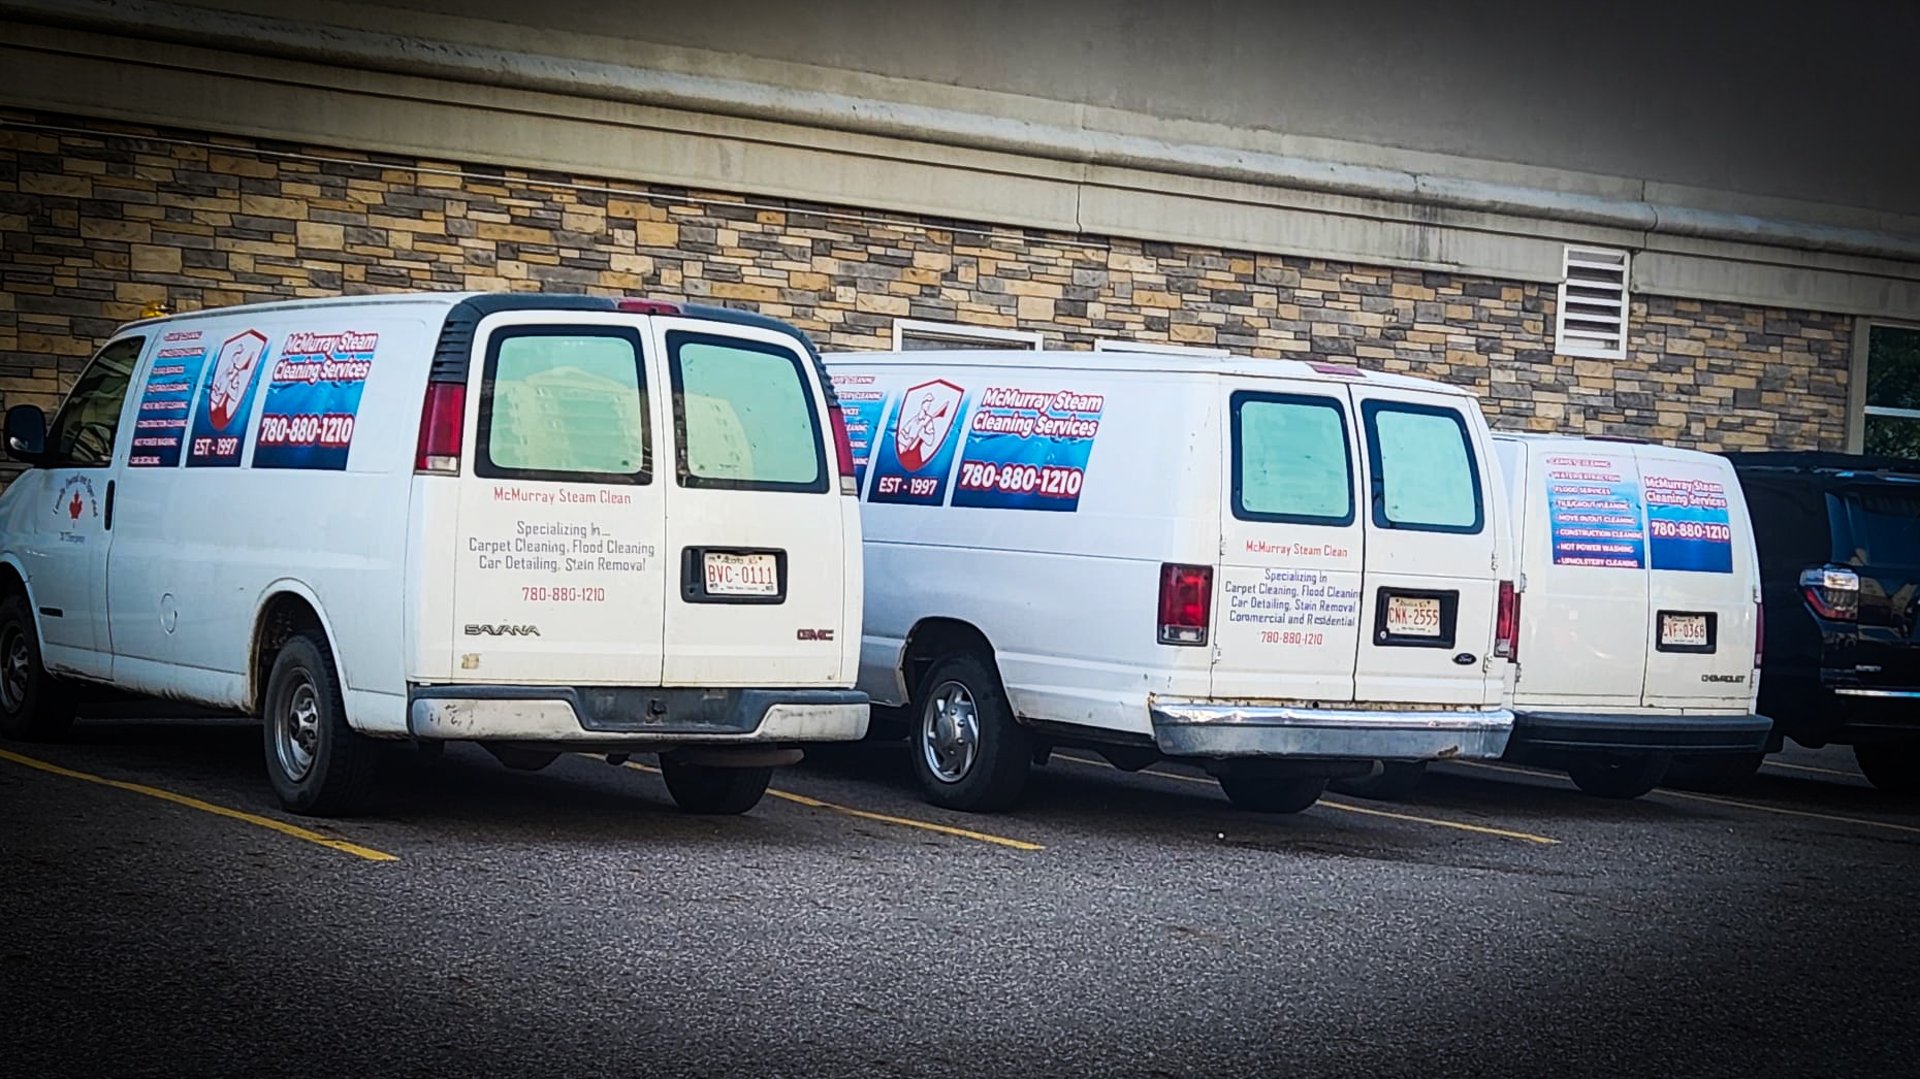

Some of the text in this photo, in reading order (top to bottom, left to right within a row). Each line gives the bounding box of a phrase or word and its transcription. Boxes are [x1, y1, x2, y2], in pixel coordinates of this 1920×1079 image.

[283, 331, 378, 358] McMurray Steam
[272, 356, 374, 384] Cleaning Services
[982, 388, 1104, 413] McMurray Steam
[260, 415, 354, 445] 780-880-1210
[972, 411, 1098, 437] Cleaning Services
[193, 438, 212, 455] EST
[216, 438, 238, 455] 1997
[878, 477, 902, 493] EST
[910, 478, 938, 495] 1997
[961, 462, 1083, 496] 780-880-1210
[1645, 476, 1724, 494] McMurray Steam
[494, 486, 631, 505] McMurray Steam Clean
[1646, 491, 1727, 508] Cleaning Services
[516, 520, 587, 539] Specializing
[1651, 521, 1729, 540] 780-880-1210
[469, 536, 512, 554] Carpet
[572, 539, 603, 554] Flood
[607, 539, 655, 557] Cleaning
[1246, 540, 1348, 558] McMurray Steam Clean
[479, 555, 501, 569] Car
[565, 558, 594, 572] Stain
[597, 557, 646, 572] Removal
[708, 564, 774, 584] BVC-0111
[1265, 568, 1317, 585] Specializing
[521, 587, 605, 602] 780-880-1210
[1225, 580, 1256, 595] Carpet
[1302, 584, 1324, 597] Flood
[1231, 595, 1248, 608] Car
[1295, 598, 1317, 611] Stain
[1319, 600, 1356, 613] Removal
[1229, 610, 1286, 625] Commercial
[1288, 613, 1305, 625] and
[1388, 606, 1439, 626] CNK-2555
[464, 624, 541, 637] SAVANA
[797, 629, 834, 641] GMC
[1261, 631, 1323, 646] 780-880-1210
